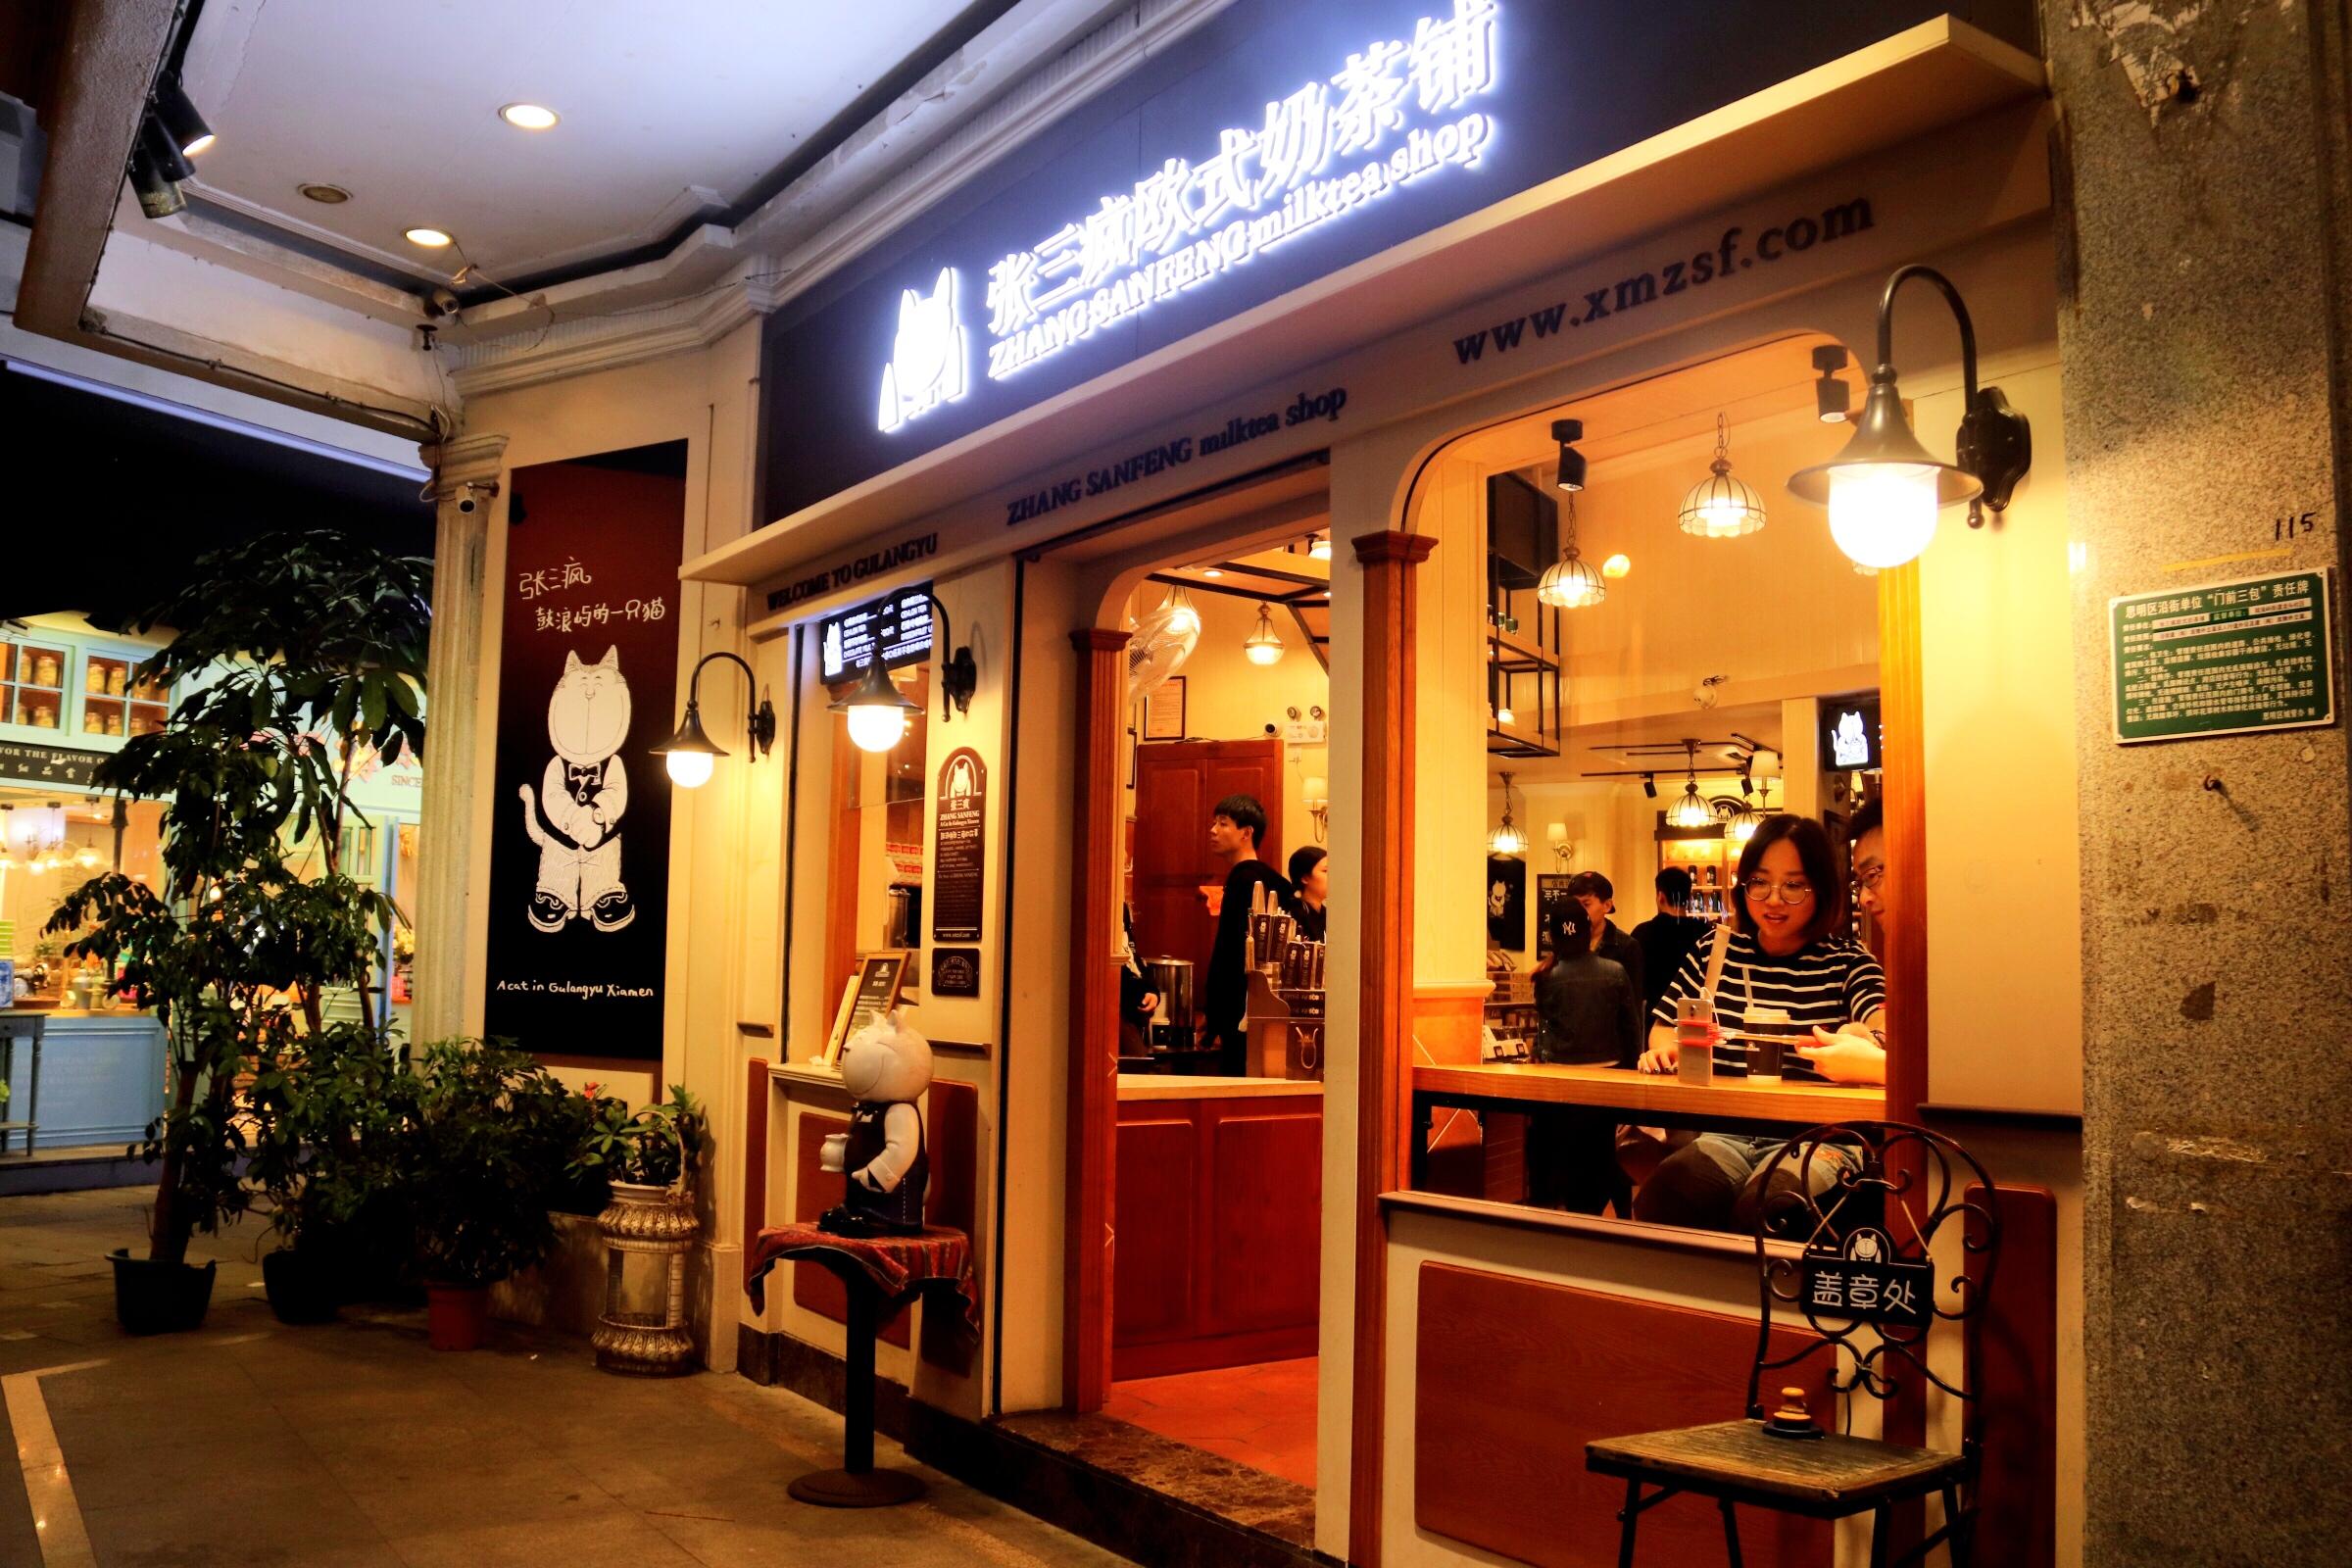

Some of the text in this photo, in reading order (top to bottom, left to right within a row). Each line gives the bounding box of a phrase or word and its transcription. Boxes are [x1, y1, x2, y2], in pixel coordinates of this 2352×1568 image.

[986, 0, 1496, 335] 张三疯欧式奶茶铺
[988, 114, 1494, 380] ZHANG SANFENG milktea shop
[1453, 197, 1875, 365] www.xmzsf.com
[1006, 387, 1348, 526] ZHANG SANFENG milktea shop
[2275, 512, 2317, 542] 115
[519, 556, 592, 600] 张三疯
[767, 533, 938, 612] WELCOME TO GULANGYU
[535, 596, 666, 633] 鼓浪屿的一只猫
[24, 749, 47, 759] THE
[392, 774, 422, 788] SINCE
[532, 980, 545, 991] in
[549, 981, 603, 1000] Gulangyu
[607, 983, 654, 997] Xiamen
[1812, 1270, 1917, 1315] 盖章处
